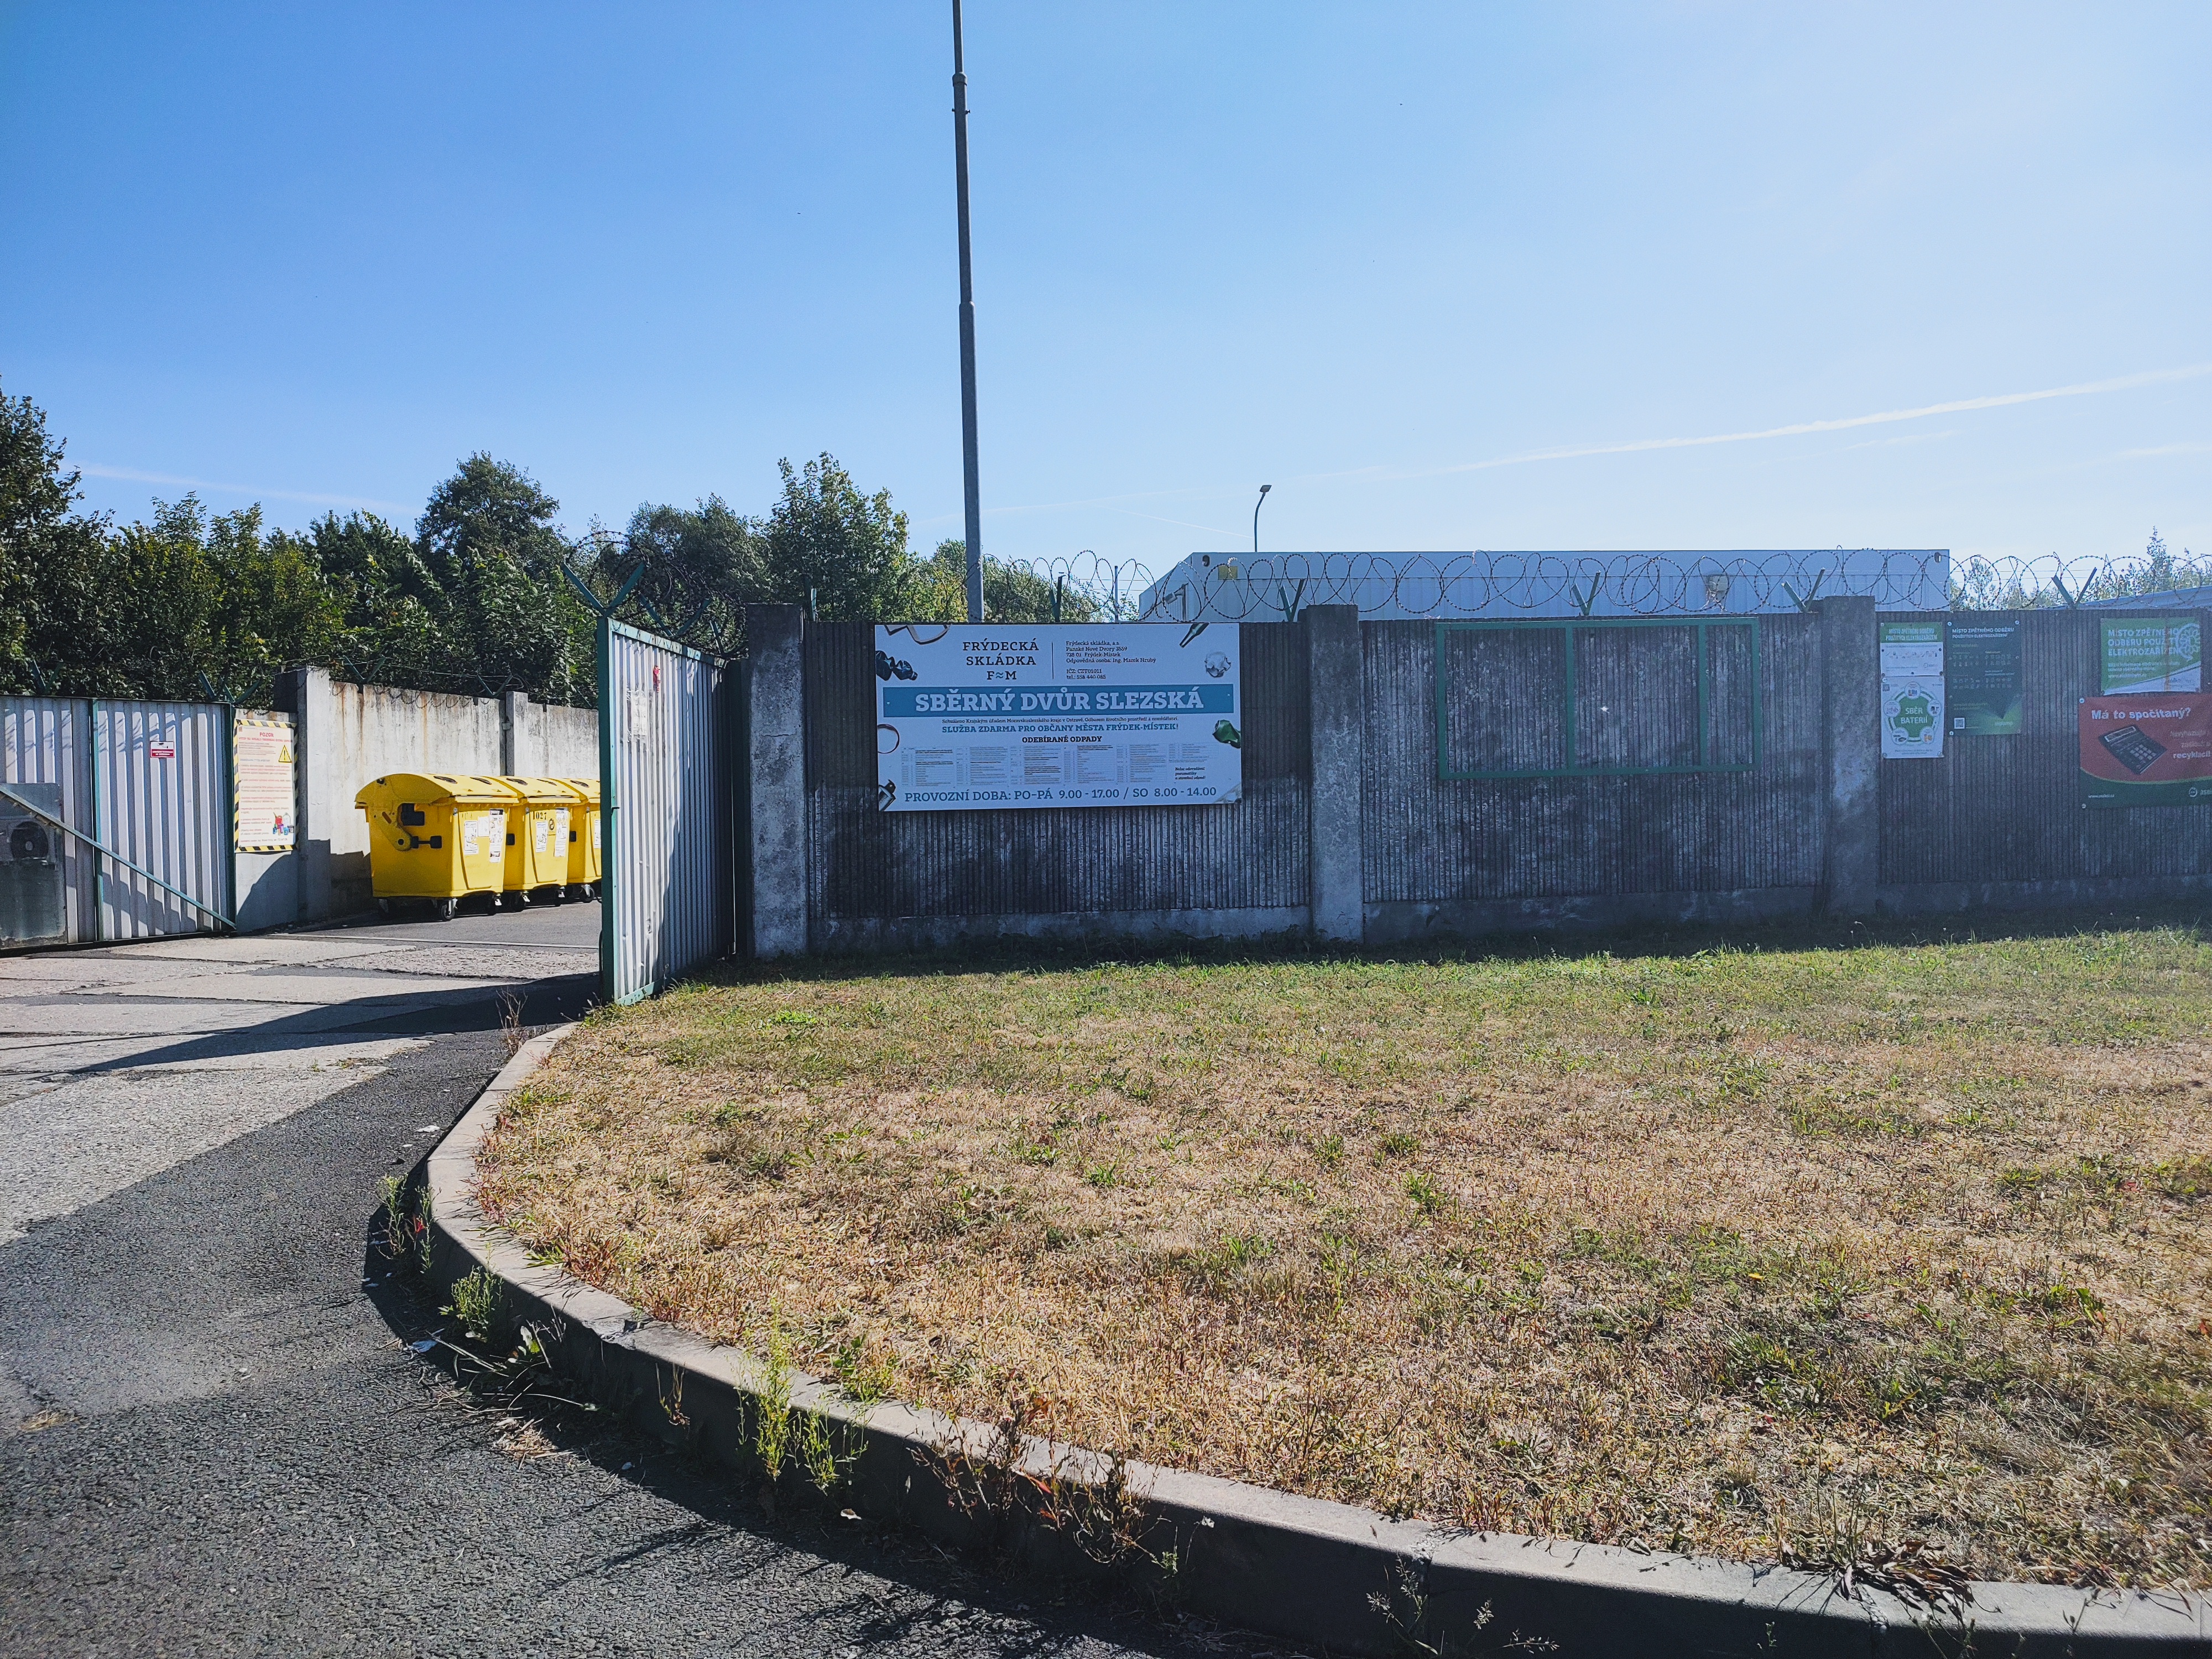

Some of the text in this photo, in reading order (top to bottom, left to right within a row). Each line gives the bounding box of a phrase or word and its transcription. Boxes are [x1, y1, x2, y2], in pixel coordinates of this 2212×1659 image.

[2107, 628, 2134, 637] MÍSTO
[963, 638, 1039, 651] FRÝDECKÁ
[2107, 638, 2142, 646] ODBĚRU
[966, 653, 1036, 666] SKLÁDKA
[915, 686, 1204, 711] SBĚRNÝ DVŮR SLEZSKÁ
[1905, 706, 1923, 714] SBĚR
[2091, 707, 2191, 721] Má to spočítaný?
[1901, 716, 1928, 724] BATERIÍ
[942, 724, 977, 733] SLUŽBA
[1037, 723, 1073, 732] OBČANY
[1076, 723, 1105, 731] MĚSTA
[1106, 722, 1178, 731] FRÝDEK-MÍSTEK!
[905, 789, 969, 802] PROVOZNÍ
[973, 791, 1011, 801] DOBA:
[1014, 787, 1053, 800] PO-PÁ
[1059, 789, 1082, 799] 9.00
[1092, 789, 1119, 799] 17.00
[1123, 787, 1129, 800] /
[1133, 788, 1149, 797] SO
[1154, 787, 1177, 797] 8.00
[1187, 787, 1217, 796] 14.00
[533, 811, 547, 820] 1027
